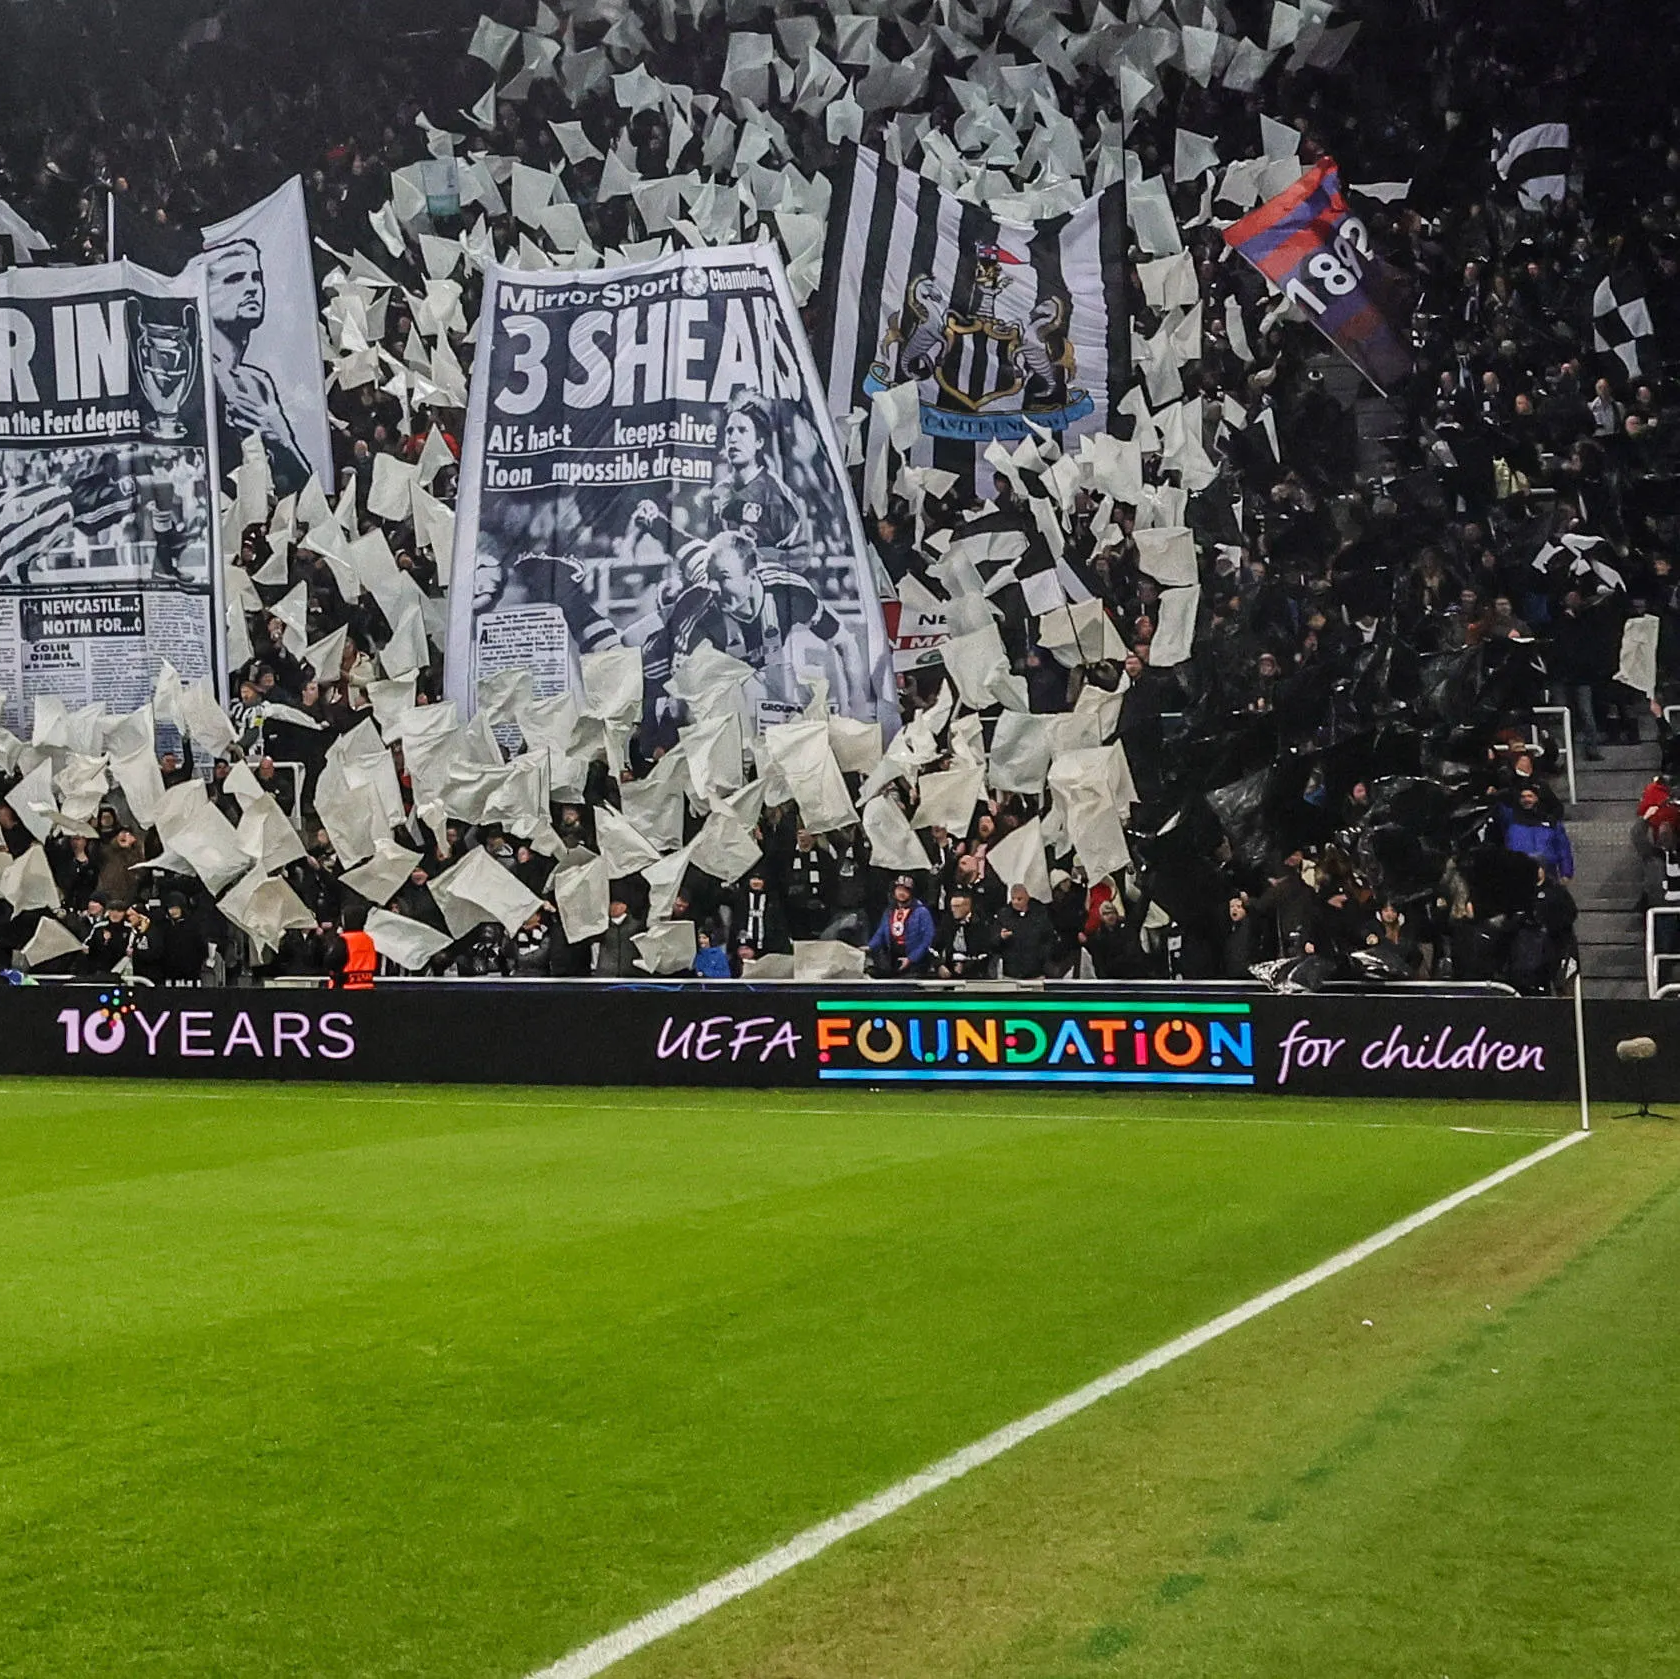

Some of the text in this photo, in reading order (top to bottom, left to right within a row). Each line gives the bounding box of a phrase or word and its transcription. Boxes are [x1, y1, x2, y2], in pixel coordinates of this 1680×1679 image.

[1286, 217, 1374, 315] 1892
[52, 298, 130, 402] IN
[493, 314, 551, 415] 3
[11, 408, 40, 434] the
[43, 407, 83, 434] Ferd
[85, 405, 140, 437] degree
[487, 424, 524, 451] Al's
[614, 418, 666, 447] keeps
[669, 413, 717, 443] alive
[485, 458, 532, 487] Toon
[653, 449, 712, 480] dream
[42, 618, 93, 635] NOTTM
[33, 643, 71, 653] COLIN
[656, 1015, 803, 1063] UEFA
[1276, 1019, 1346, 1085] for
[1361, 1023, 1546, 1072] children
